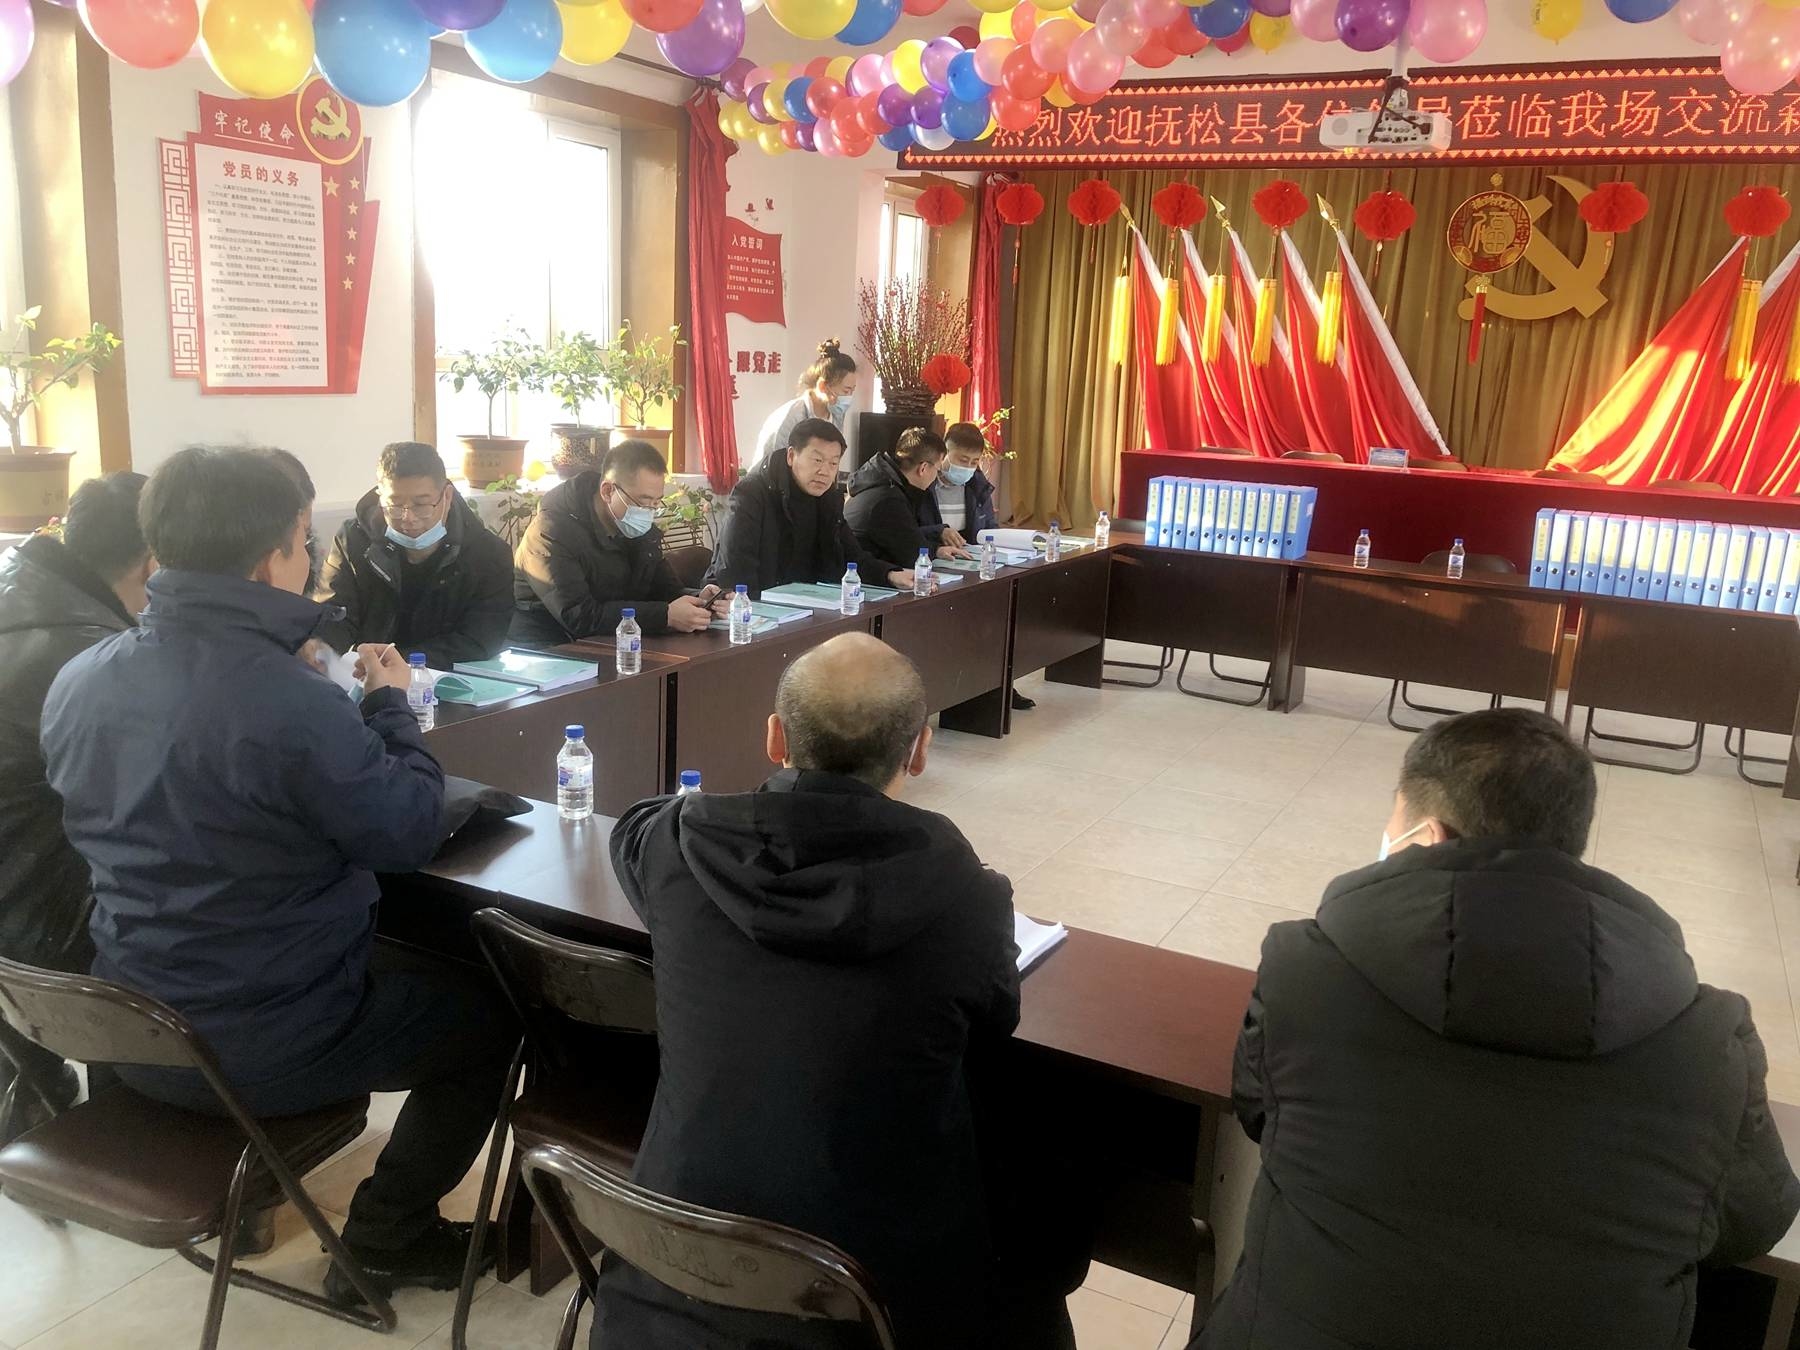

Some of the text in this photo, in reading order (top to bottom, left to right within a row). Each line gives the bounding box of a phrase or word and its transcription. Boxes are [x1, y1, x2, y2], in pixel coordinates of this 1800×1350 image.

[214, 109, 295, 145] 牢记使命
[222, 160, 300, 187] 党员的义务
[1467, 210, 1511, 255] 福
